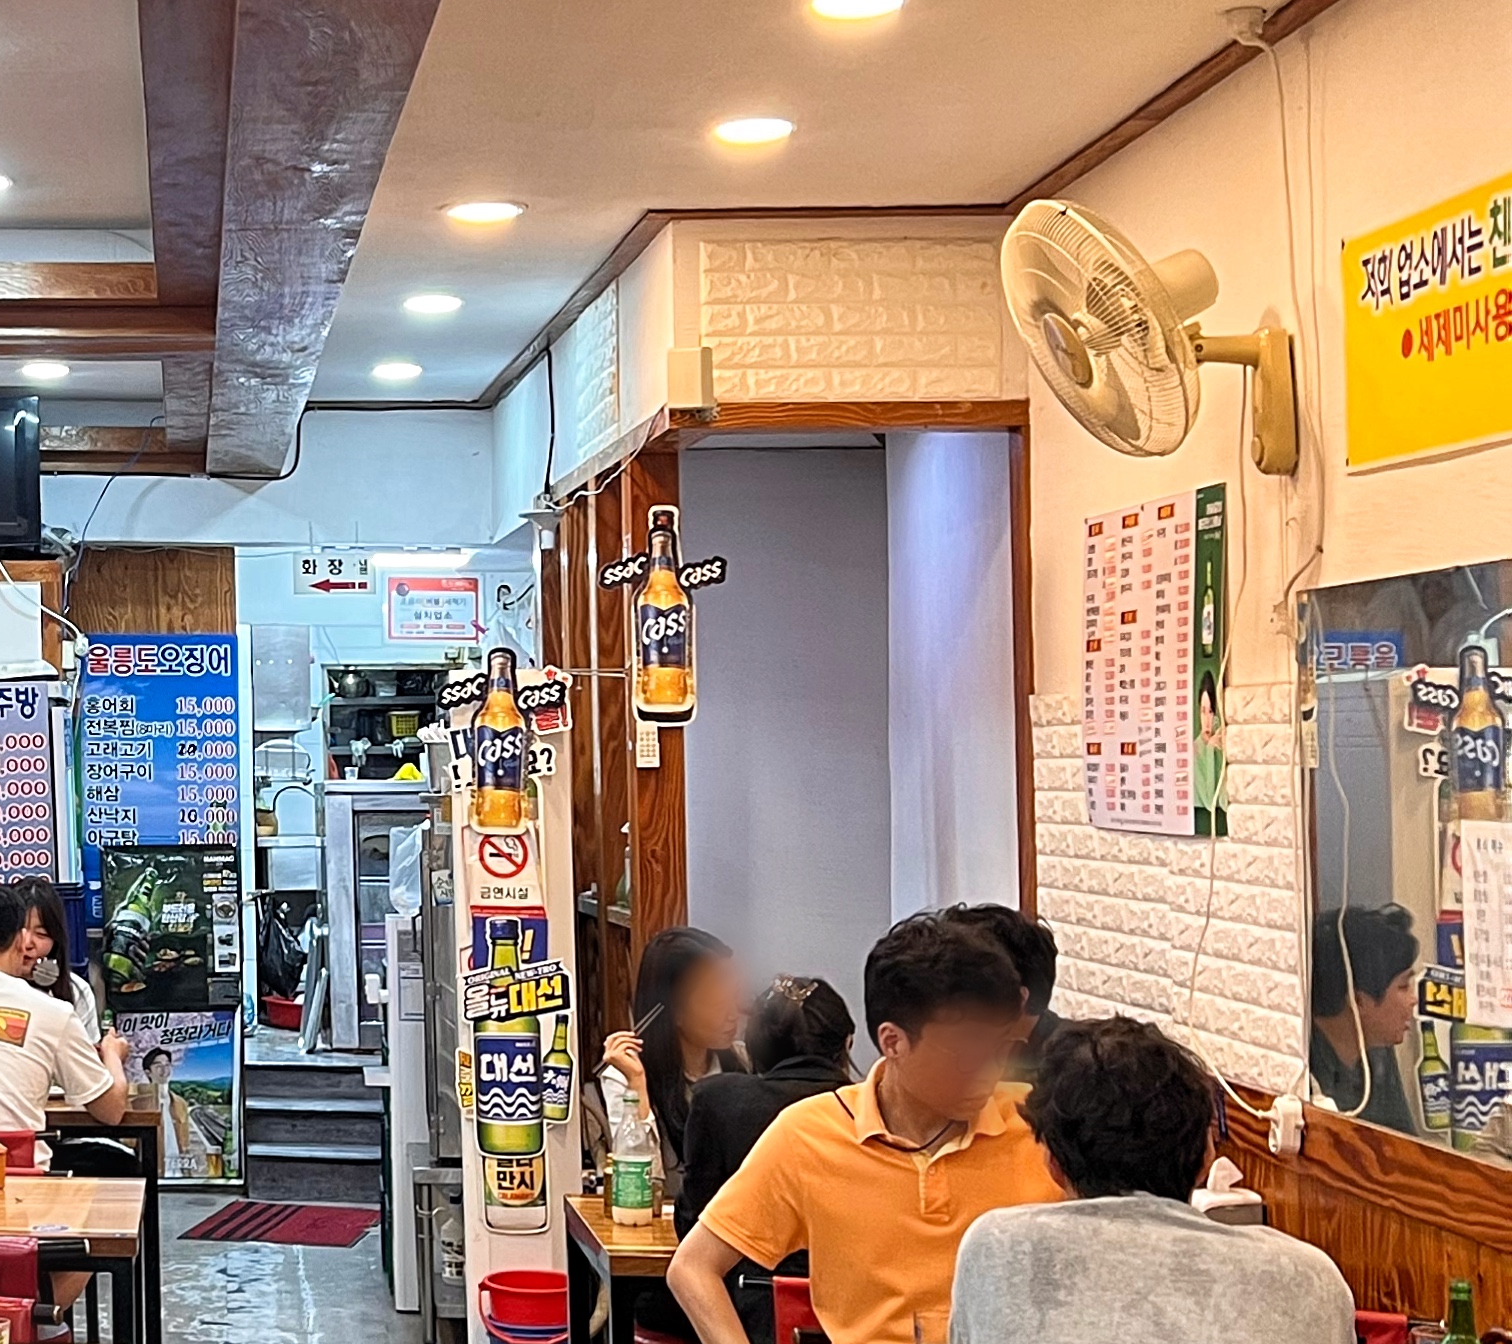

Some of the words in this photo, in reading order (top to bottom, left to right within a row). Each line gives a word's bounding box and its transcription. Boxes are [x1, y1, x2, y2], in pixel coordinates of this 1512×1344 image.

[1361, 247, 1394, 310] 저희
[1397, 215, 1484, 302] 업소에서는
[88, 646, 229, 675] 울릉도오징어
[86, 696, 134, 714] 홍어회
[176, 698, 235, 716] 15,000
[177, 719, 236, 738] 15,000
[86, 741, 152, 758] 고래고기
[86, 763, 152, 780] 장어구이
[178, 764, 236, 781] 15,000
[86, 785, 120, 802] 해삼
[178, 786, 236, 803] 15,000
[87, 807, 137, 824] 산낙지
[479, 886, 529, 900] 금연시설
[122, 1017, 138, 1033] 이
[139, 1012, 169, 1031] 맛이
[479, 1052, 538, 1083] 대선
